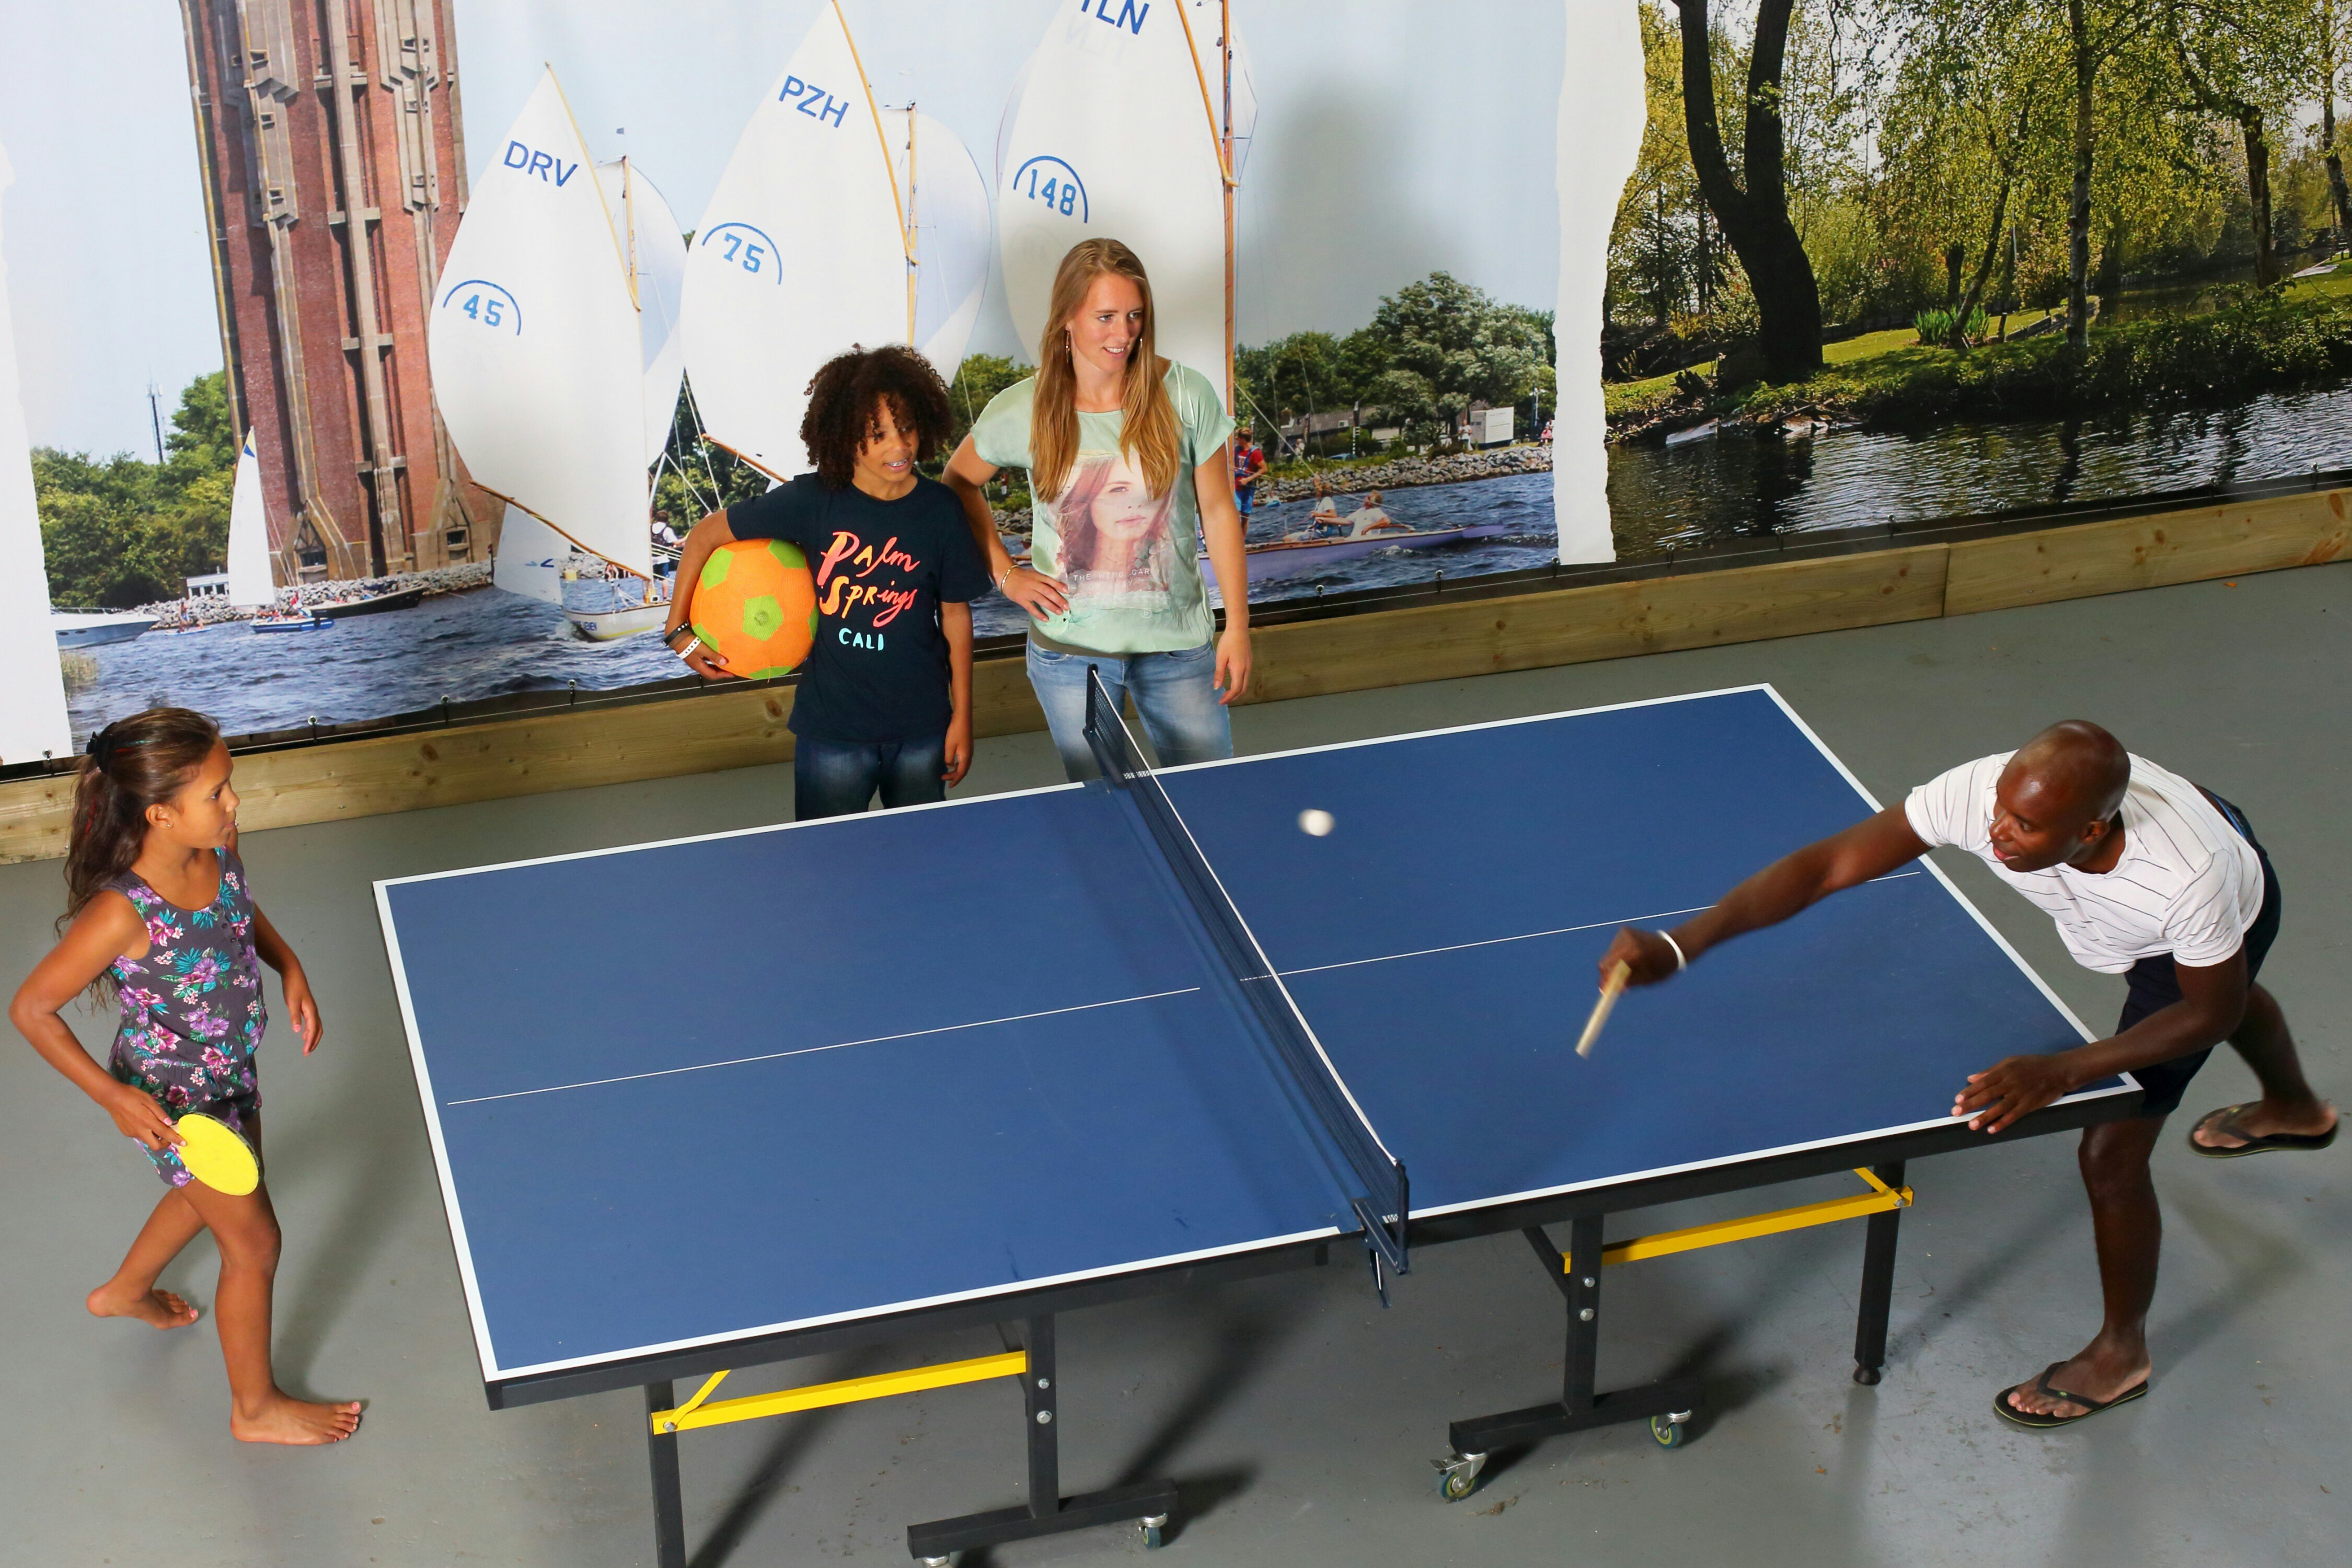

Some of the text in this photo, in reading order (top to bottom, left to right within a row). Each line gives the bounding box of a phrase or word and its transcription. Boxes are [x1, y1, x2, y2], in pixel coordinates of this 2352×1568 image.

[778, 75, 849, 129] PZH
[503, 140, 579, 188] DRV
[1028, 169, 1076, 216] 148
[723, 233, 765, 273] 75
[462, 294, 504, 327] 45
[1073, 573, 1091, 582] THE
[838, 627, 884, 651] CALI
